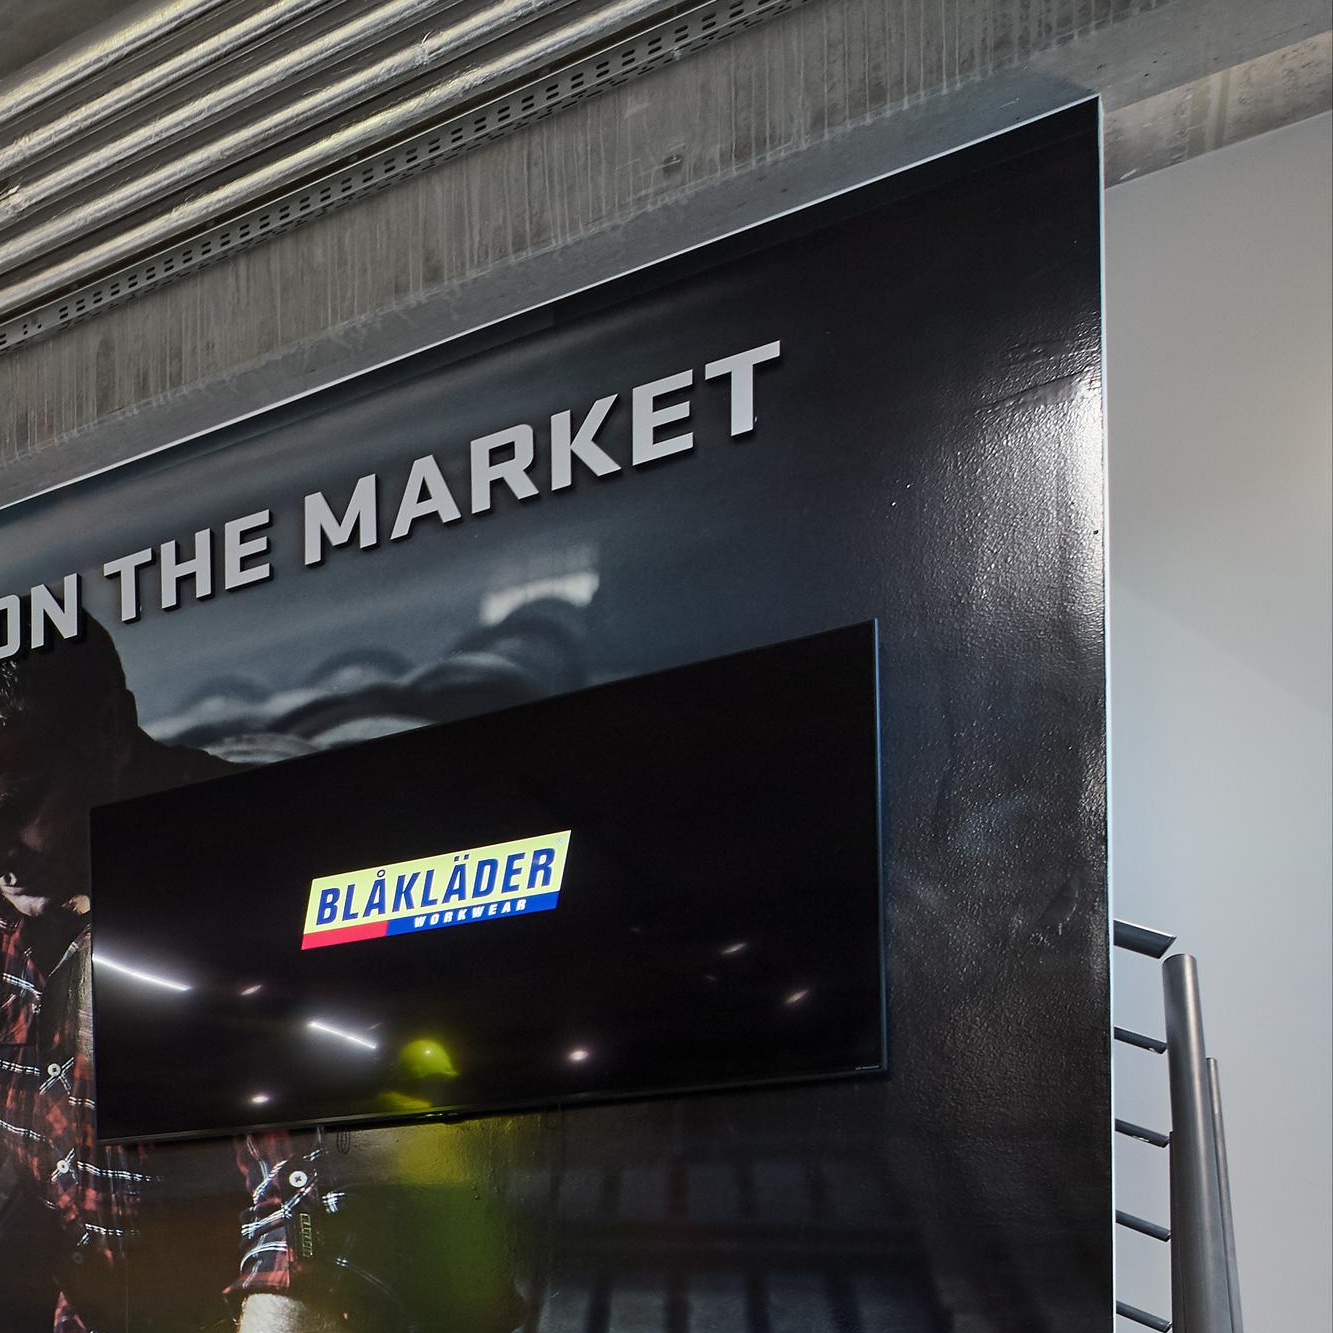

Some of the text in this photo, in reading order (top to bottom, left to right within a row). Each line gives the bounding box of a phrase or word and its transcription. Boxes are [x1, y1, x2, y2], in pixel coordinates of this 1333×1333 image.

[103, 508, 272, 623] THE
[304, 340, 781, 566] MARKET
[316, 847, 556, 926] BLÅKLÄDER
[414, 899, 527, 928] WORKWEAR
